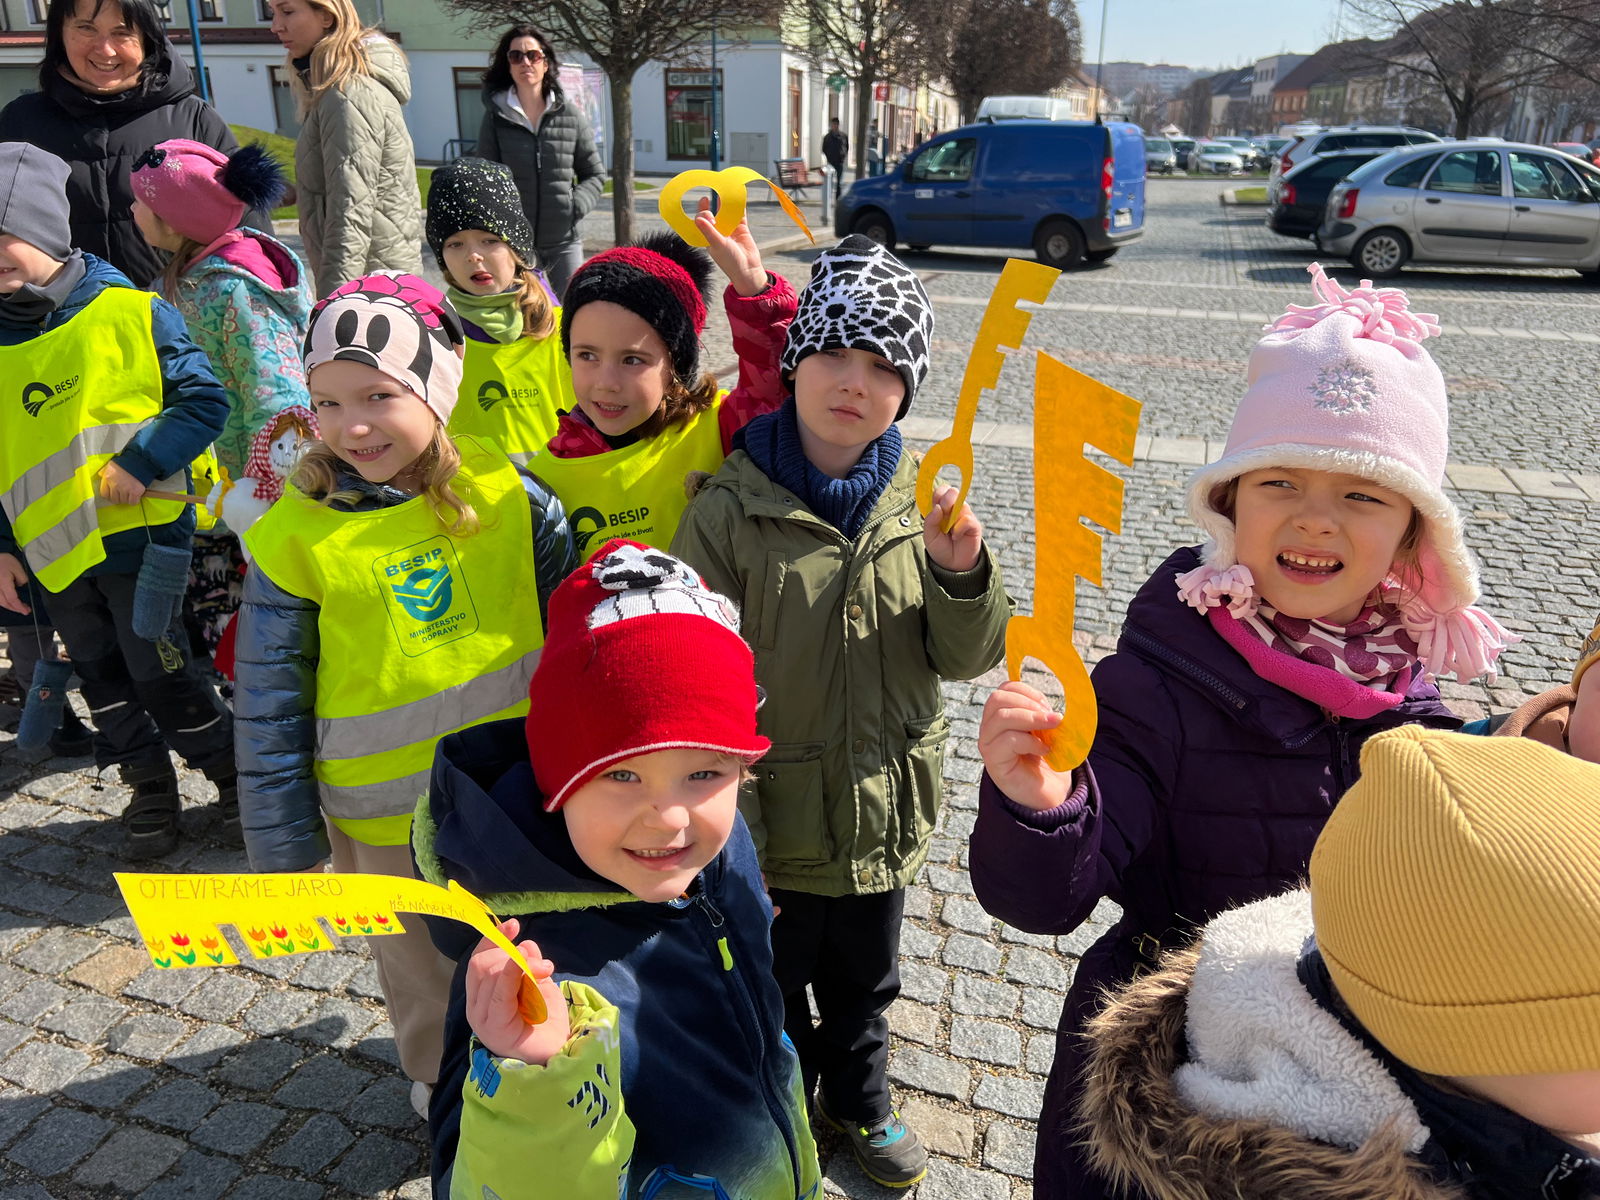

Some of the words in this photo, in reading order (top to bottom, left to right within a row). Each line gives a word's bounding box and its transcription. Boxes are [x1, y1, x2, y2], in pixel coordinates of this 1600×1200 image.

[55, 375, 79, 394] BESIP
[511, 388, 539, 398] BESIP
[609, 507, 650, 527] BESIP
[385, 548, 442, 577] BESIP
[409, 612, 466, 639] MINISTERSTVO
[422, 624, 459, 643] DOPRAVY
[139, 876, 279, 899] OTEVÍRÁME
[285, 878, 344, 898] JARO
